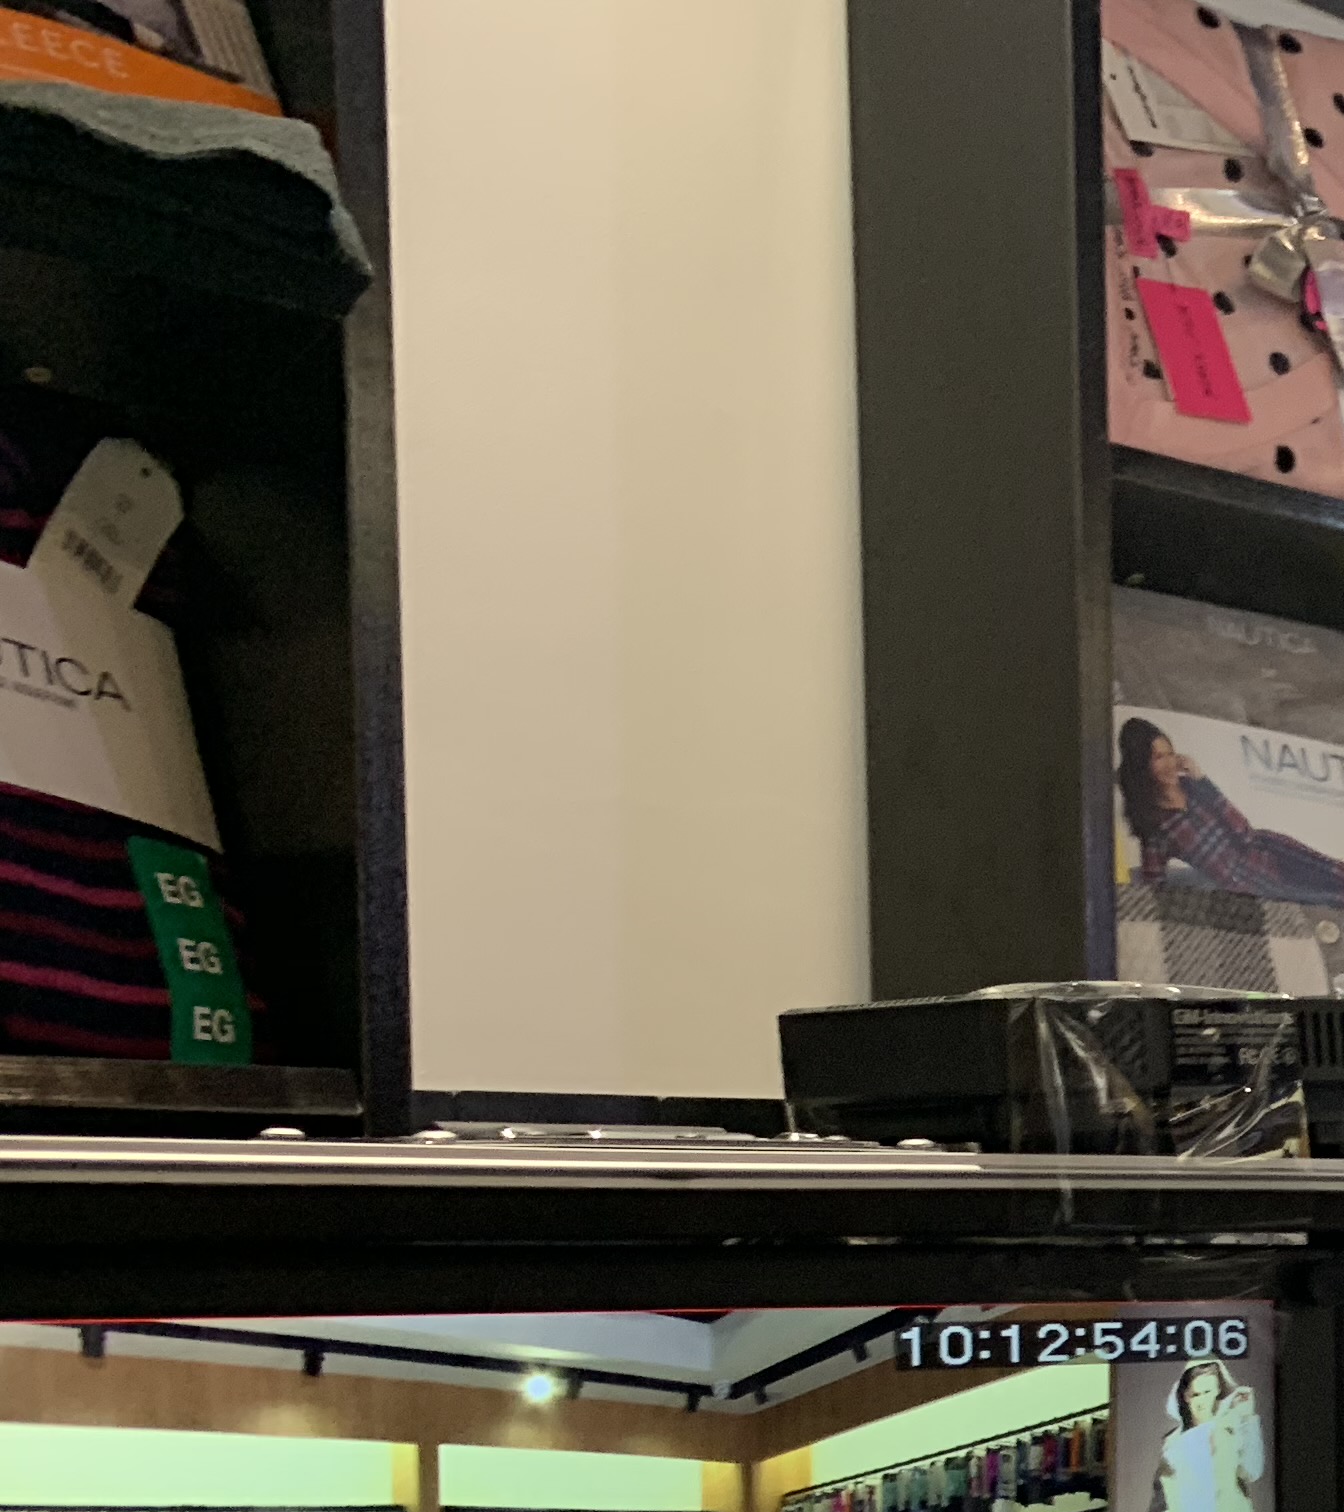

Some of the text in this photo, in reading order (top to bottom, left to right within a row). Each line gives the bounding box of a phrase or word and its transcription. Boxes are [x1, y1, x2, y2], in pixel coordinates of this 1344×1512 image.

[0, 22, 130, 79] EECE
[0, 638, 132, 712] TICA
[154, 872, 205, 908] EG
[177, 938, 223, 975] EG
[193, 1005, 236, 1043] EG
[900, 1319, 1248, 1367] 10:12:54:06
